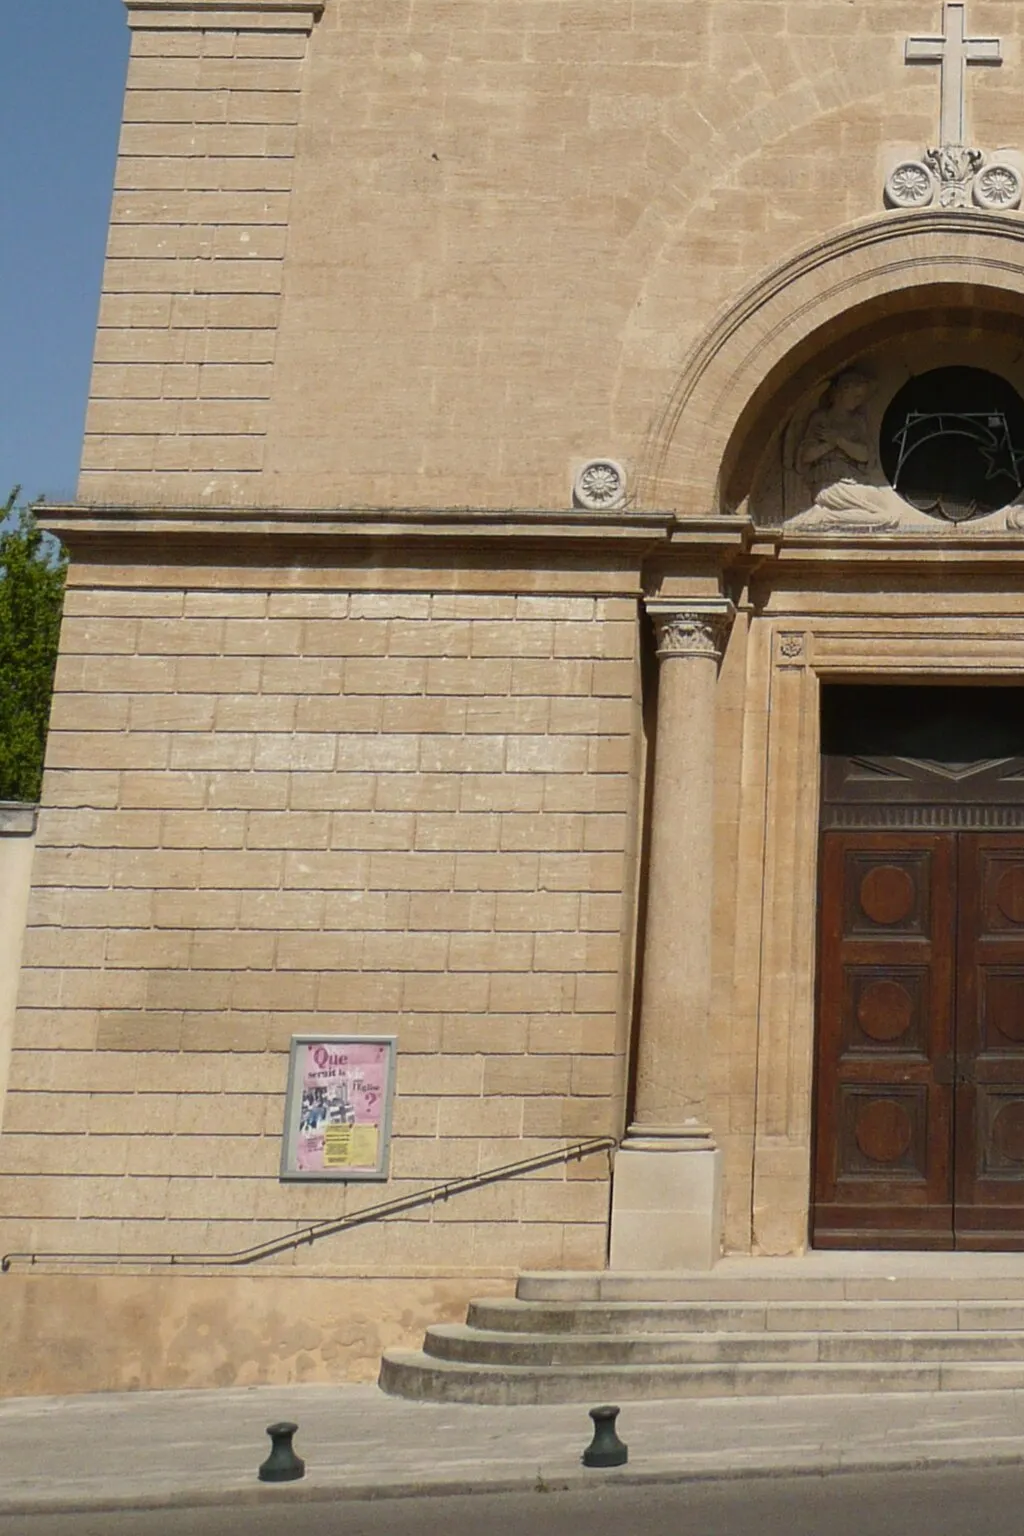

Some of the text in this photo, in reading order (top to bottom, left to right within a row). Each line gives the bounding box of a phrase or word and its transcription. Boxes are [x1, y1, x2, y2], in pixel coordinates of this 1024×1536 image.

[314, 1047, 348, 1069] Que
[308, 1067, 336, 1079] serait
[364, 1092, 377, 1113] ?
